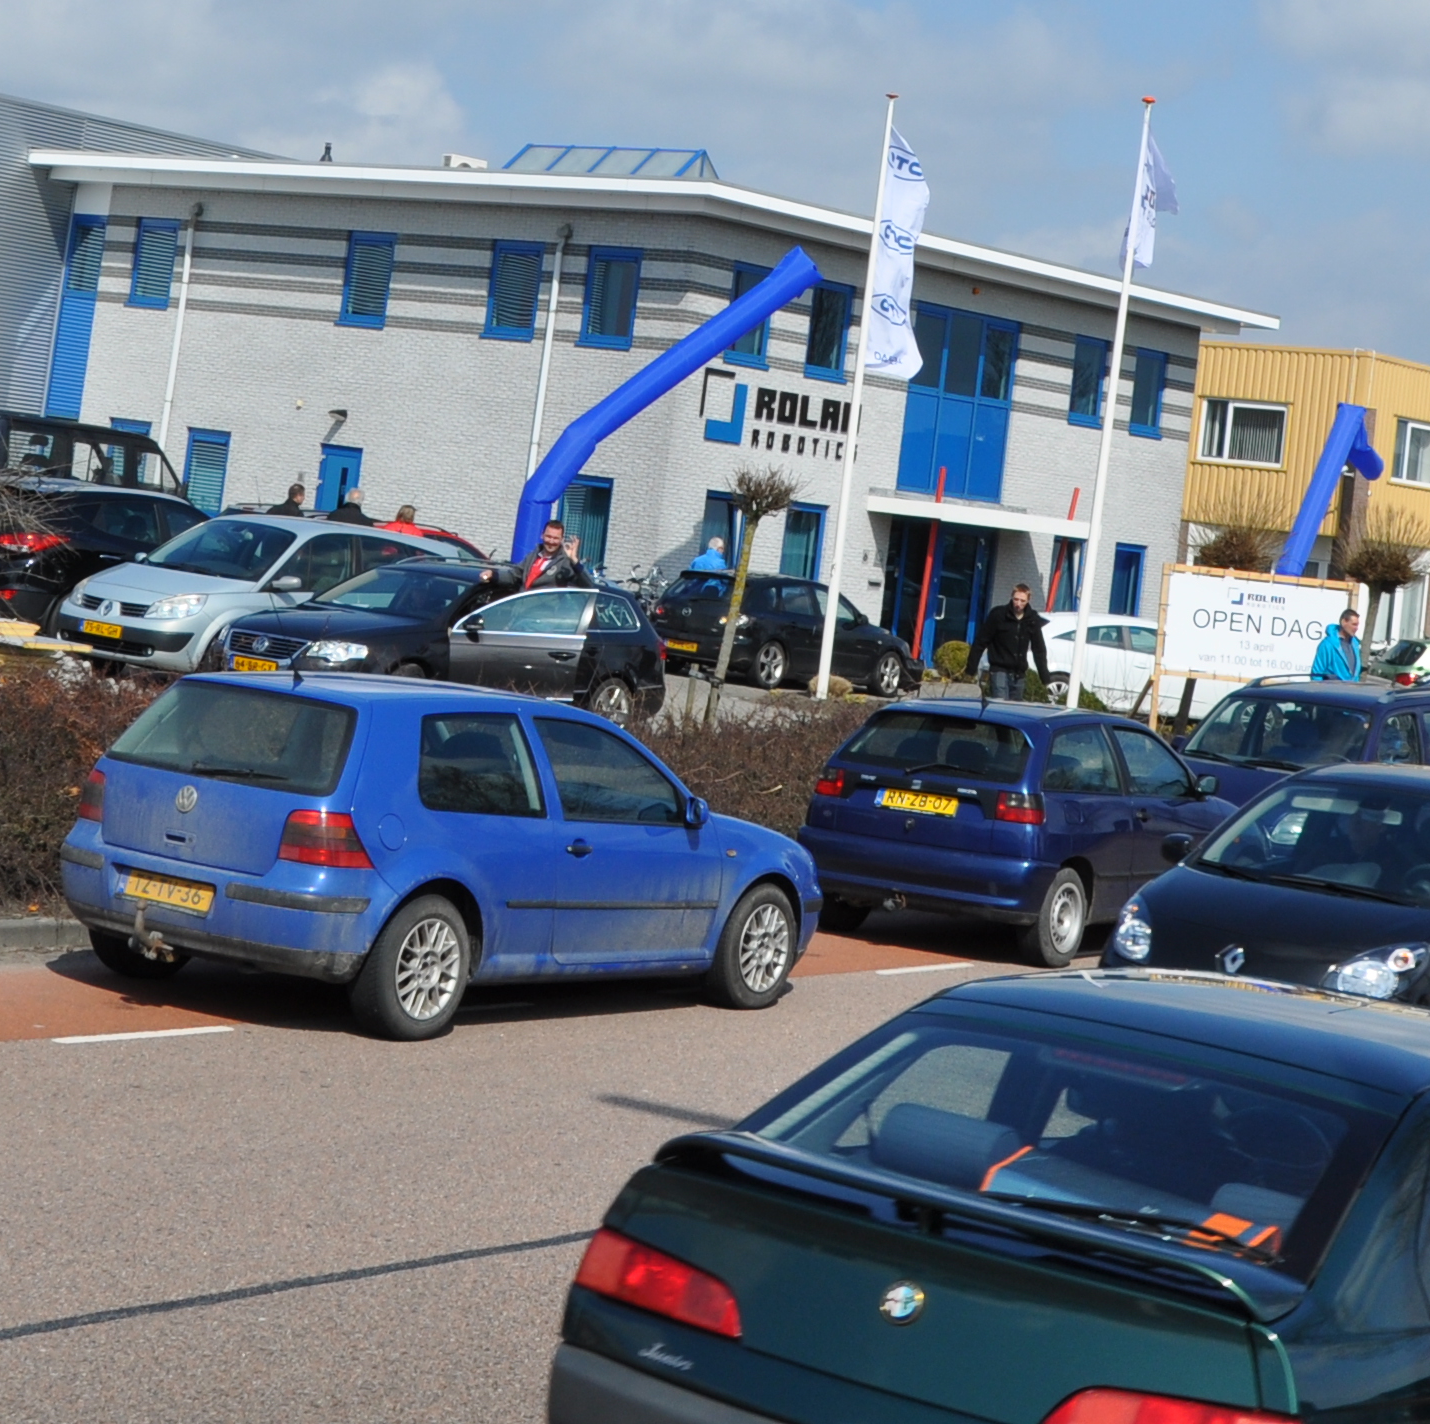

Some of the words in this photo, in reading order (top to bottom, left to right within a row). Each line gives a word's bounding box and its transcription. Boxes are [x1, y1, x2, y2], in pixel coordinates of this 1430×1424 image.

[1193, 608, 1262, 634] OPEN
[1271, 616, 1323, 640] DAG
[1239, 640, 1251, 651] 13
[1253, 642, 1275, 653] april
[1198, 654, 1216, 663] van
[1220, 654, 1247, 666] 11.00
[1250, 657, 1262, 668] tot
[1266, 659, 1293, 671] 16.00
[885, 791, 953, 811] RN-ZB-07
